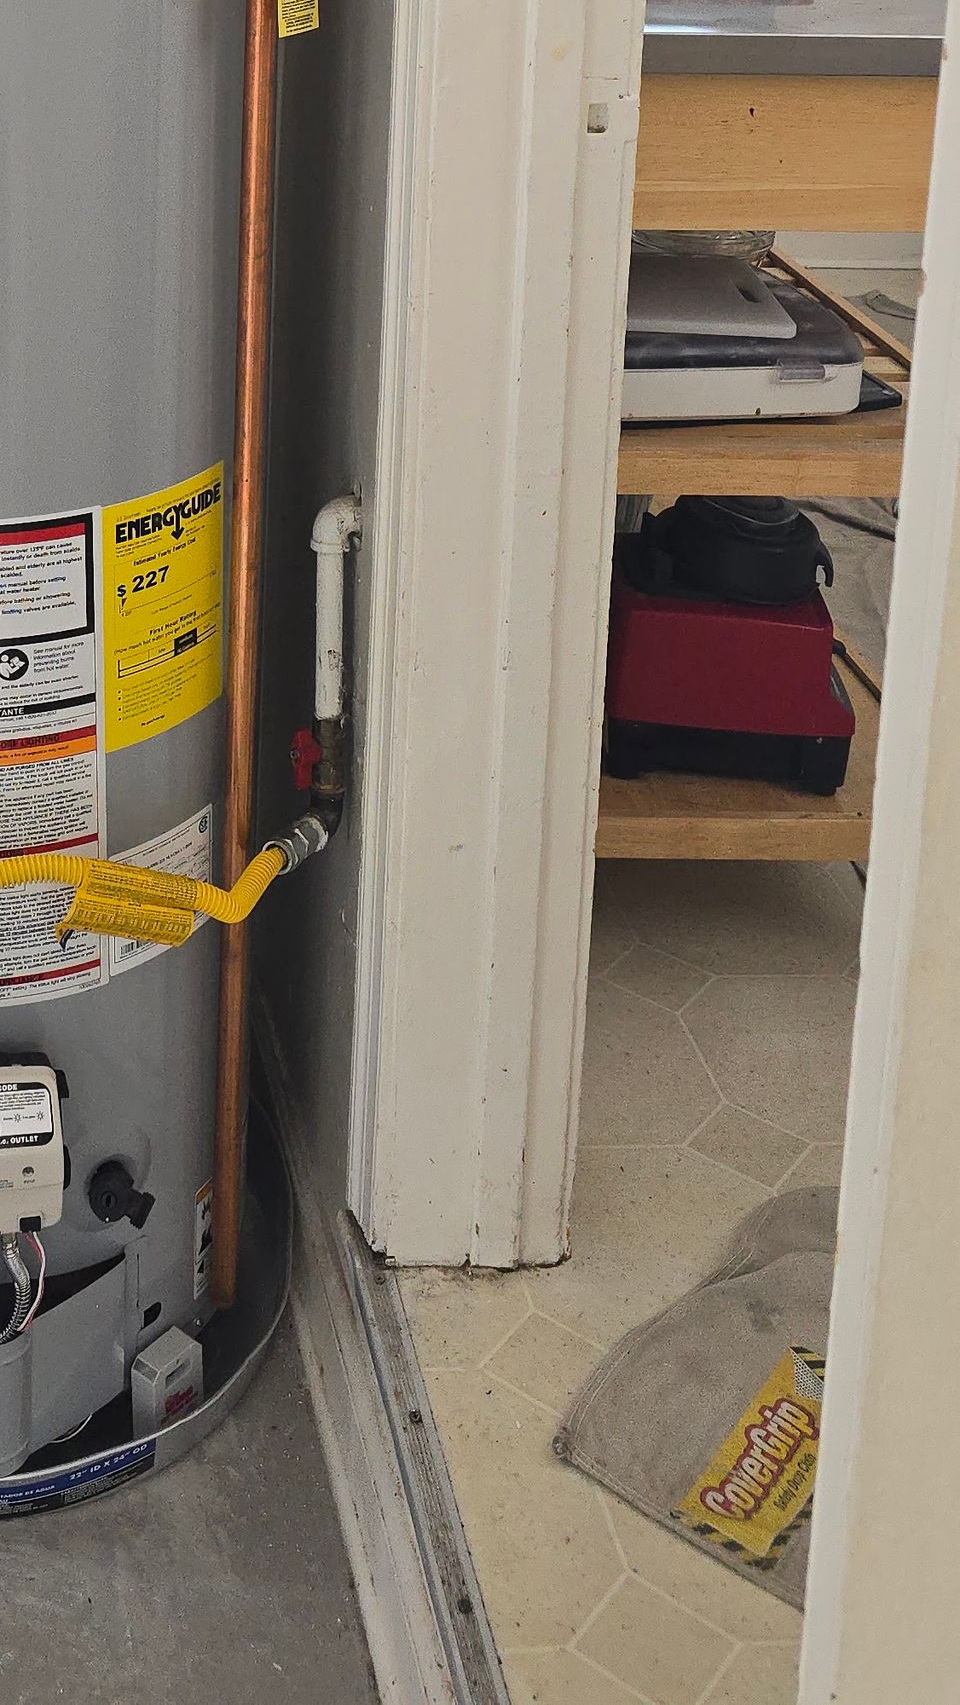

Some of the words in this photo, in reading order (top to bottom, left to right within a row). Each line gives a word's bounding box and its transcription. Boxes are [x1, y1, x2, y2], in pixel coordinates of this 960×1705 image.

[116, 481, 221, 544] ENERGYGUIDE
[43, 592, 70, 600] showering
[117, 584, 126, 598] $
[132, 565, 169, 593] 227
[149, 625, 164, 636] First
[179, 610, 197, 622] Rating
[34, 652, 61, 660] information
[90, 1464, 101, 1473] ID
[132, 1443, 148, 1455] OD
[703, 1401, 816, 1520] CoverGrip
